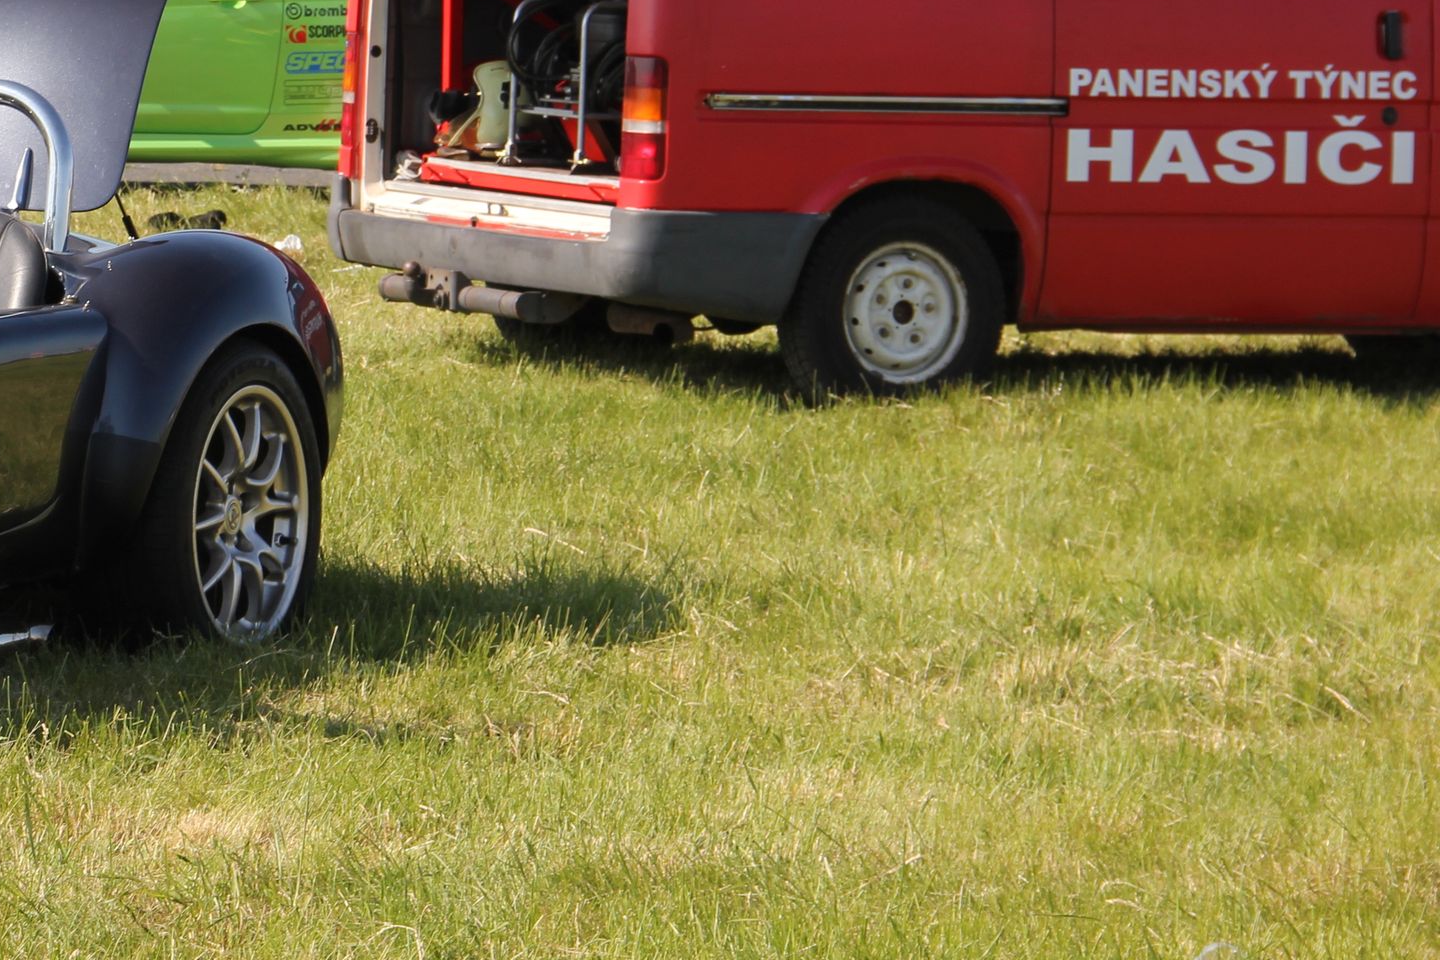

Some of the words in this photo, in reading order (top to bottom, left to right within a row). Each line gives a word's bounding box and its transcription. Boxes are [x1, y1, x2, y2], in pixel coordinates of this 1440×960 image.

[1068, 63, 1278, 98] PANENSKÝ
[1288, 64, 1417, 100] TÝNEC
[1066, 114, 1416, 185] HASIČI
